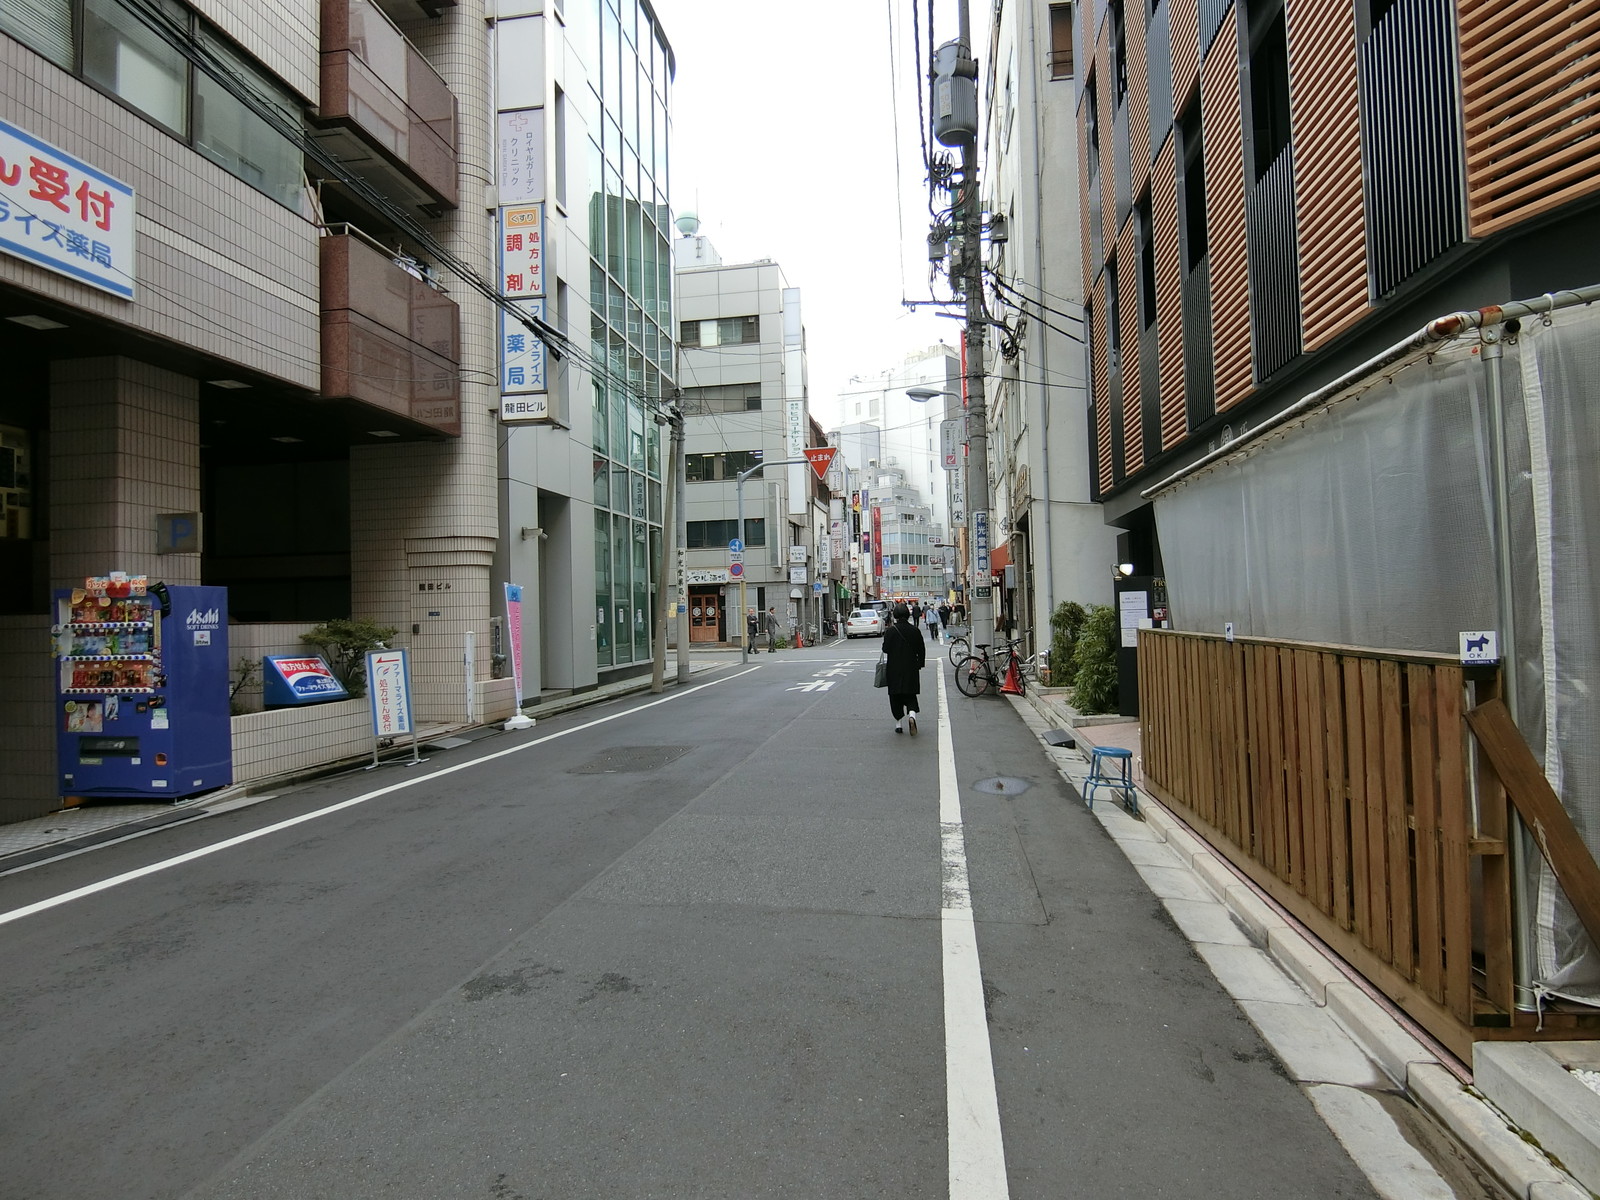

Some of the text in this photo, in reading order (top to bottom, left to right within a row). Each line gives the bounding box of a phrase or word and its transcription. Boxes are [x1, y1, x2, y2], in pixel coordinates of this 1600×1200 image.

[510, 138, 520, 186] クリニック
[525, 132, 534, 194] ロイヤルガーデン
[510, 213, 535, 223] くすり
[506, 233, 523, 291] 調剤
[528, 232, 540, 291] 処方せん
[506, 333, 525, 386] 薬局
[530, 305, 542, 385] フマライズ
[504, 401, 547, 414] 龍田ビル
[810, 453, 831, 462] 止まれ
[953, 492, 963, 521] 広栄
[171, 518, 193, 548] P
[186, 608, 219, 625] Asahi
[379, 678, 392, 732] 処方せん受付
